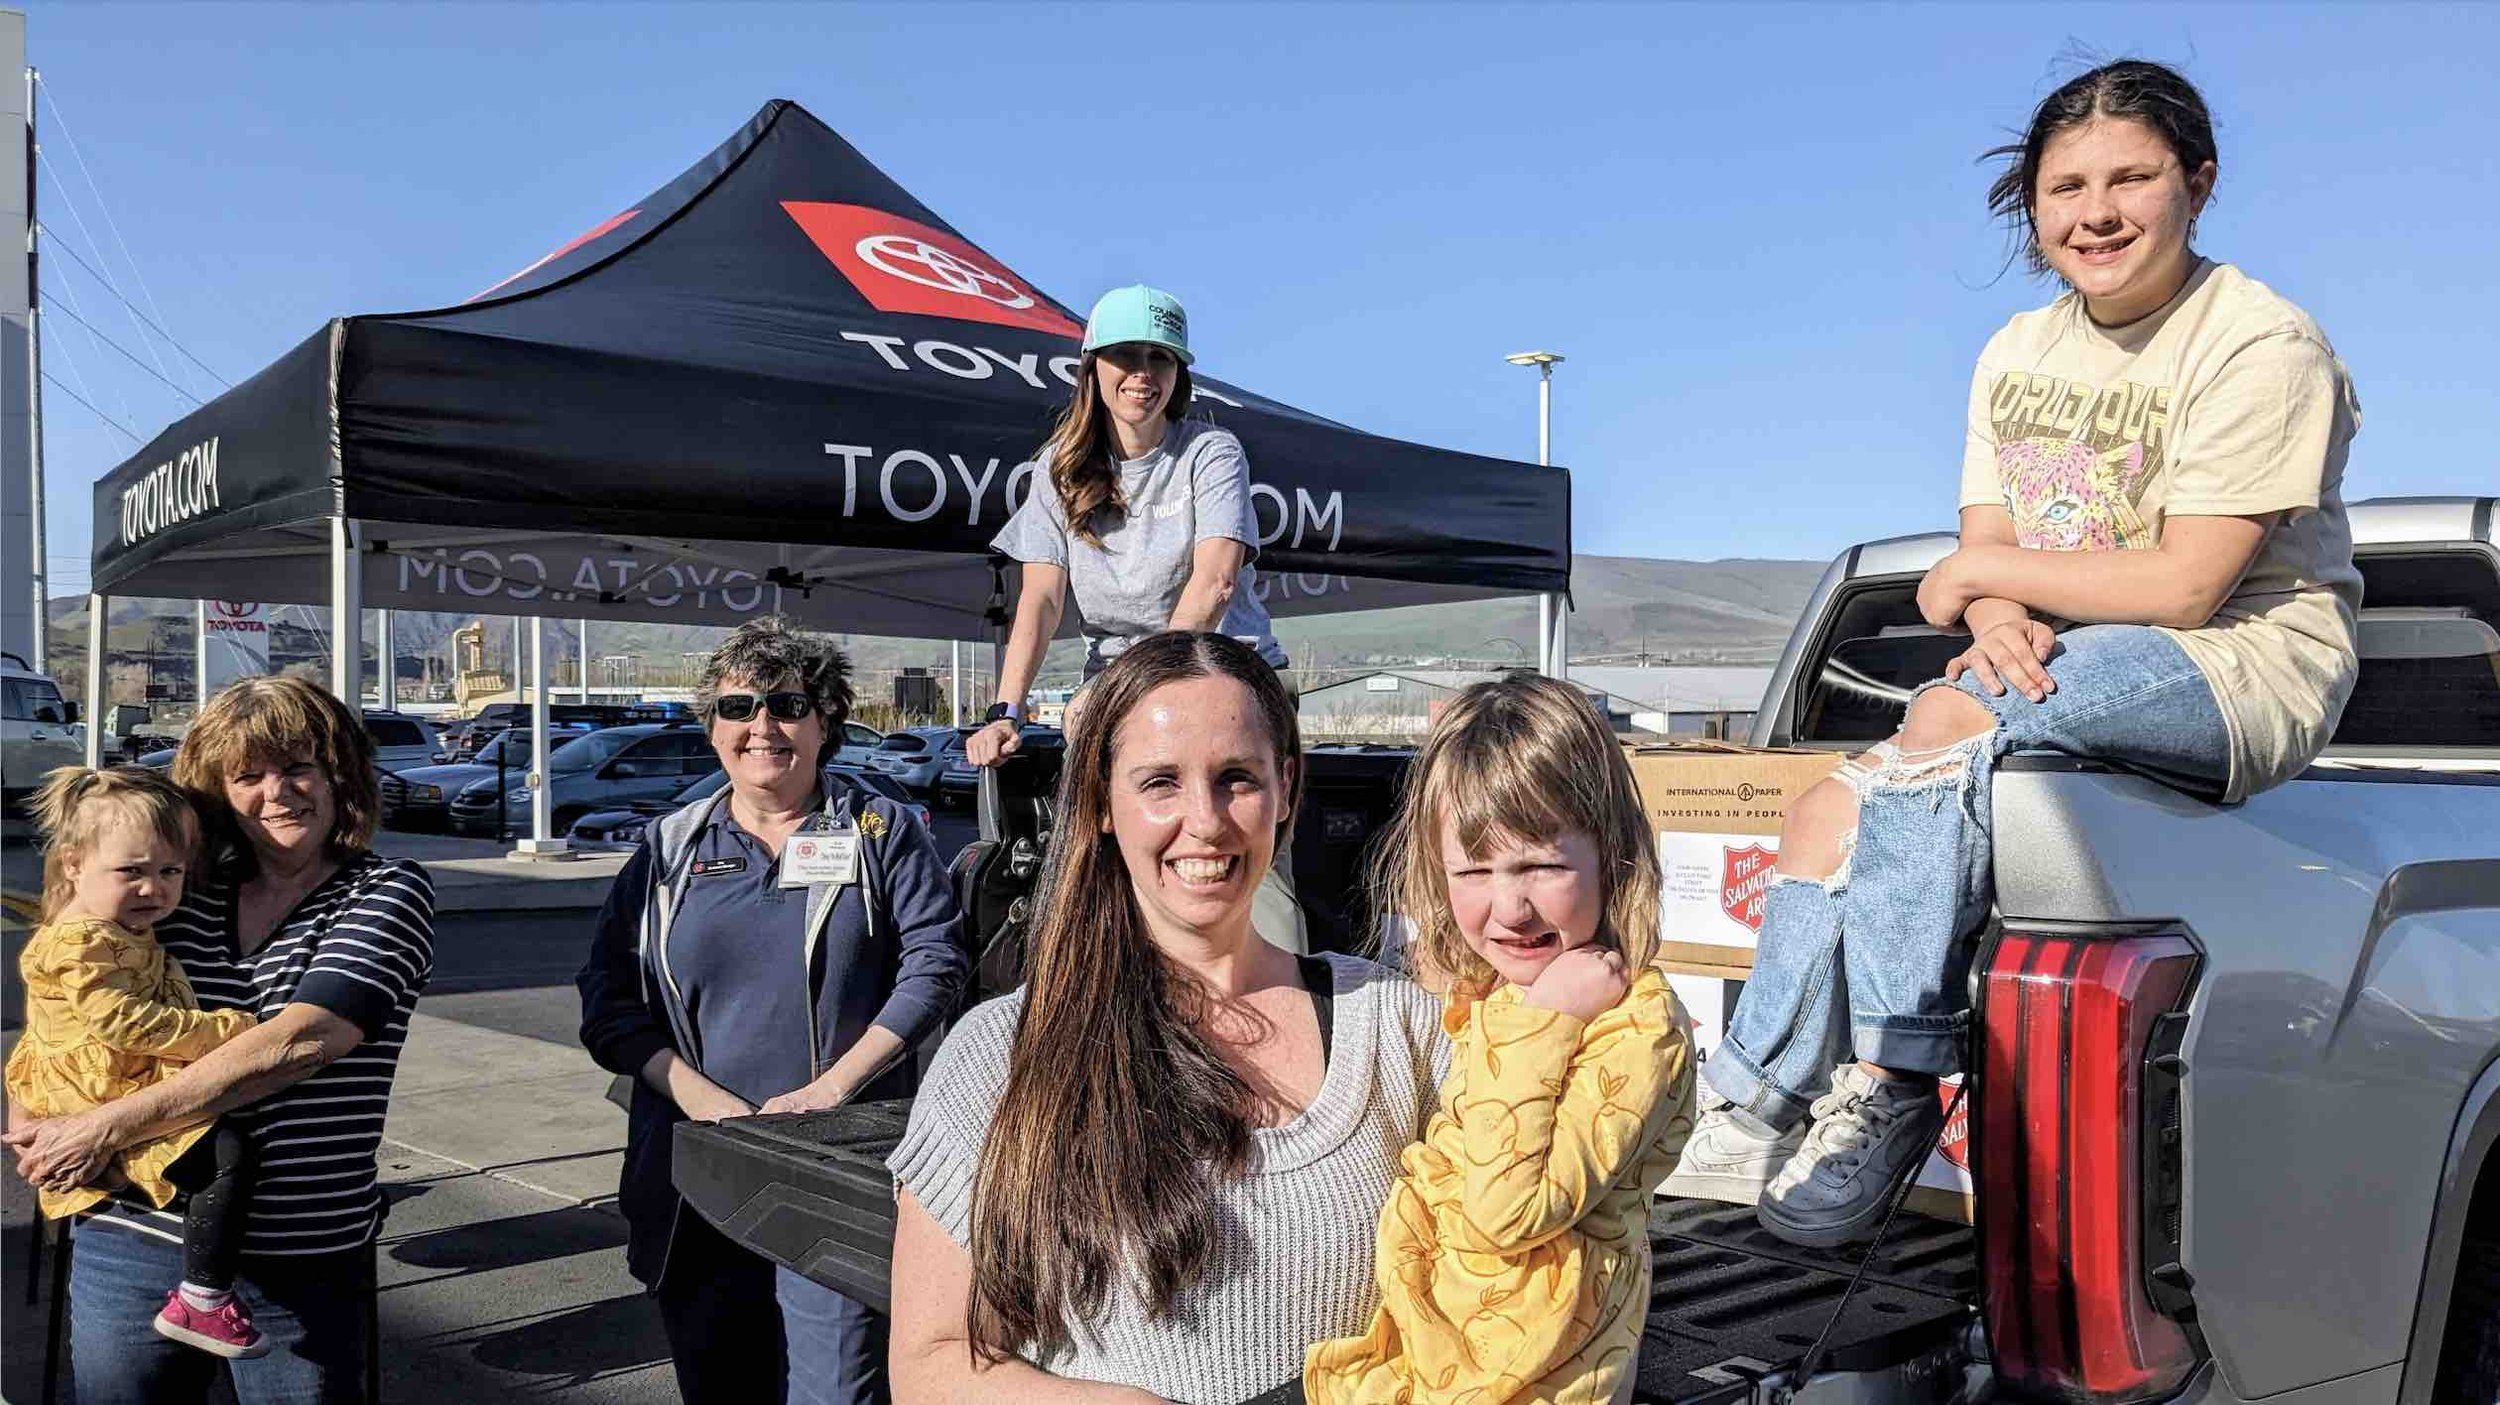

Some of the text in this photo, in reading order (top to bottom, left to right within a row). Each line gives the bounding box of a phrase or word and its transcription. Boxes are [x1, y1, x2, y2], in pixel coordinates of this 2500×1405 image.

[122, 436, 220, 546] TOYOTA.COM
[207, 620, 266, 631] TOYOTA
[1666, 787, 1783, 797] INTERNATIONAL PAPER
[1726, 809, 1740, 818] IN
[1746, 809, 1785, 819] PEOPL
[1734, 852, 1762, 880] THE
[1725, 864, 1777, 909] SALVATIO
